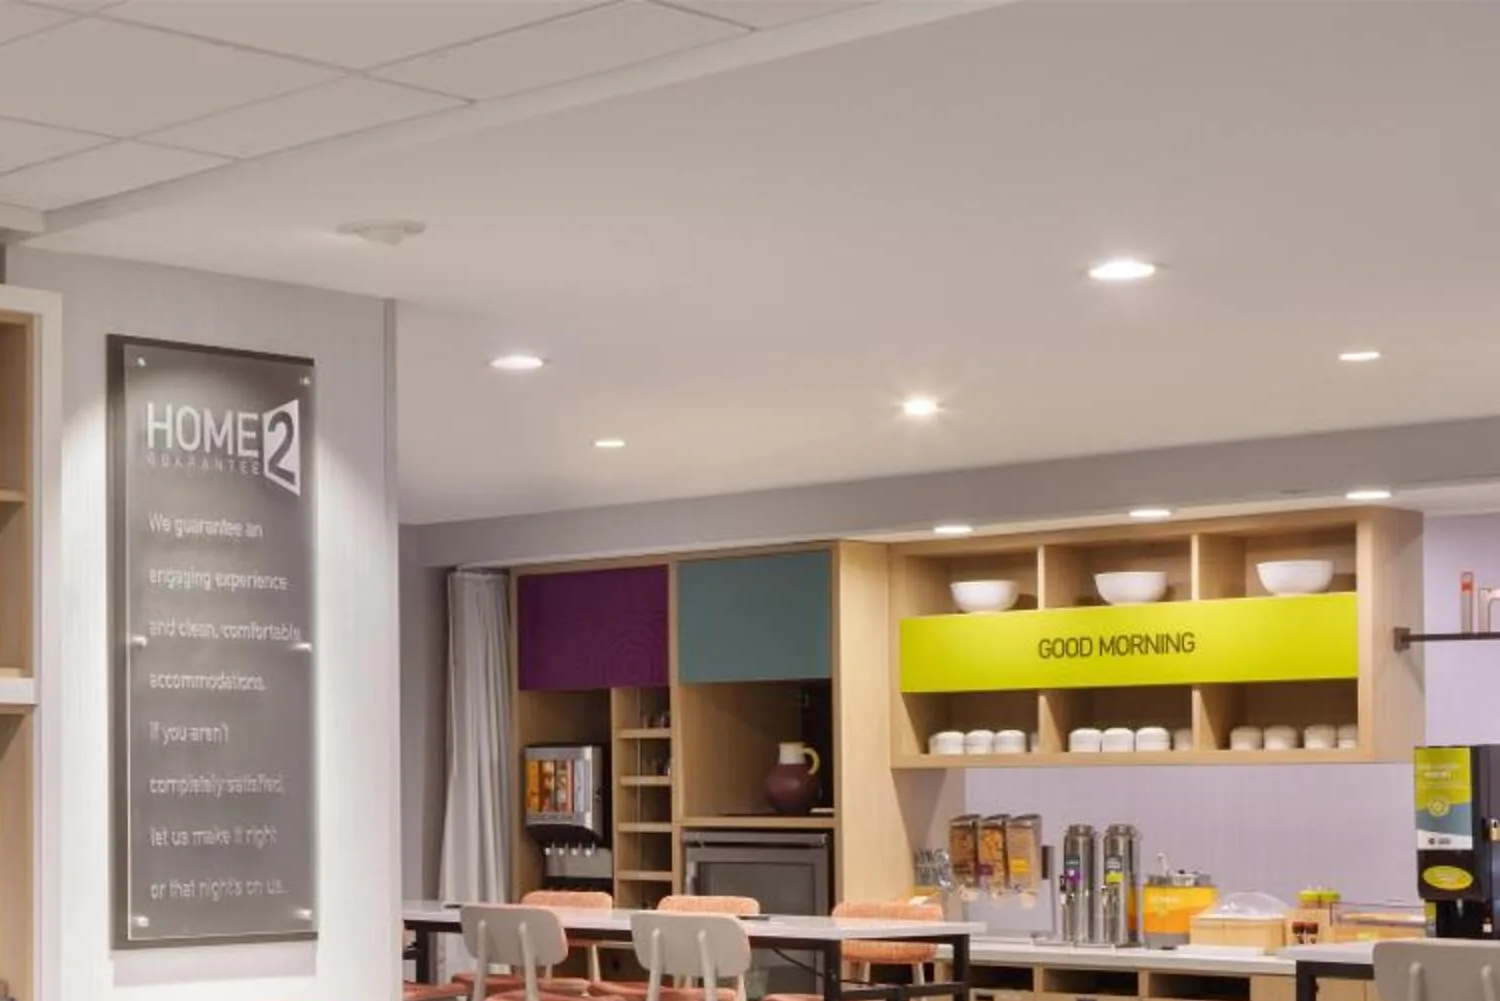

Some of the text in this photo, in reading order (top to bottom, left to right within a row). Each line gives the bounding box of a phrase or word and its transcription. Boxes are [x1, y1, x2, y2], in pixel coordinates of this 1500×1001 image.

[147, 402, 298, 491] HOME 2
[149, 512, 263, 538] We guarantee an
[150, 567, 289, 592] engaging experience
[150, 617, 175, 637] and
[1038, 631, 1196, 660] GOOD MORNING
[162, 727, 187, 746] you
[150, 774, 222, 799] completely
[151, 827, 167, 846] let
[171, 831, 188, 846] us
[193, 827, 230, 846] make
[245, 825, 277, 850] right
[151, 883, 165, 900] or
[170, 878, 195, 897] that
[246, 880, 263, 896] on
